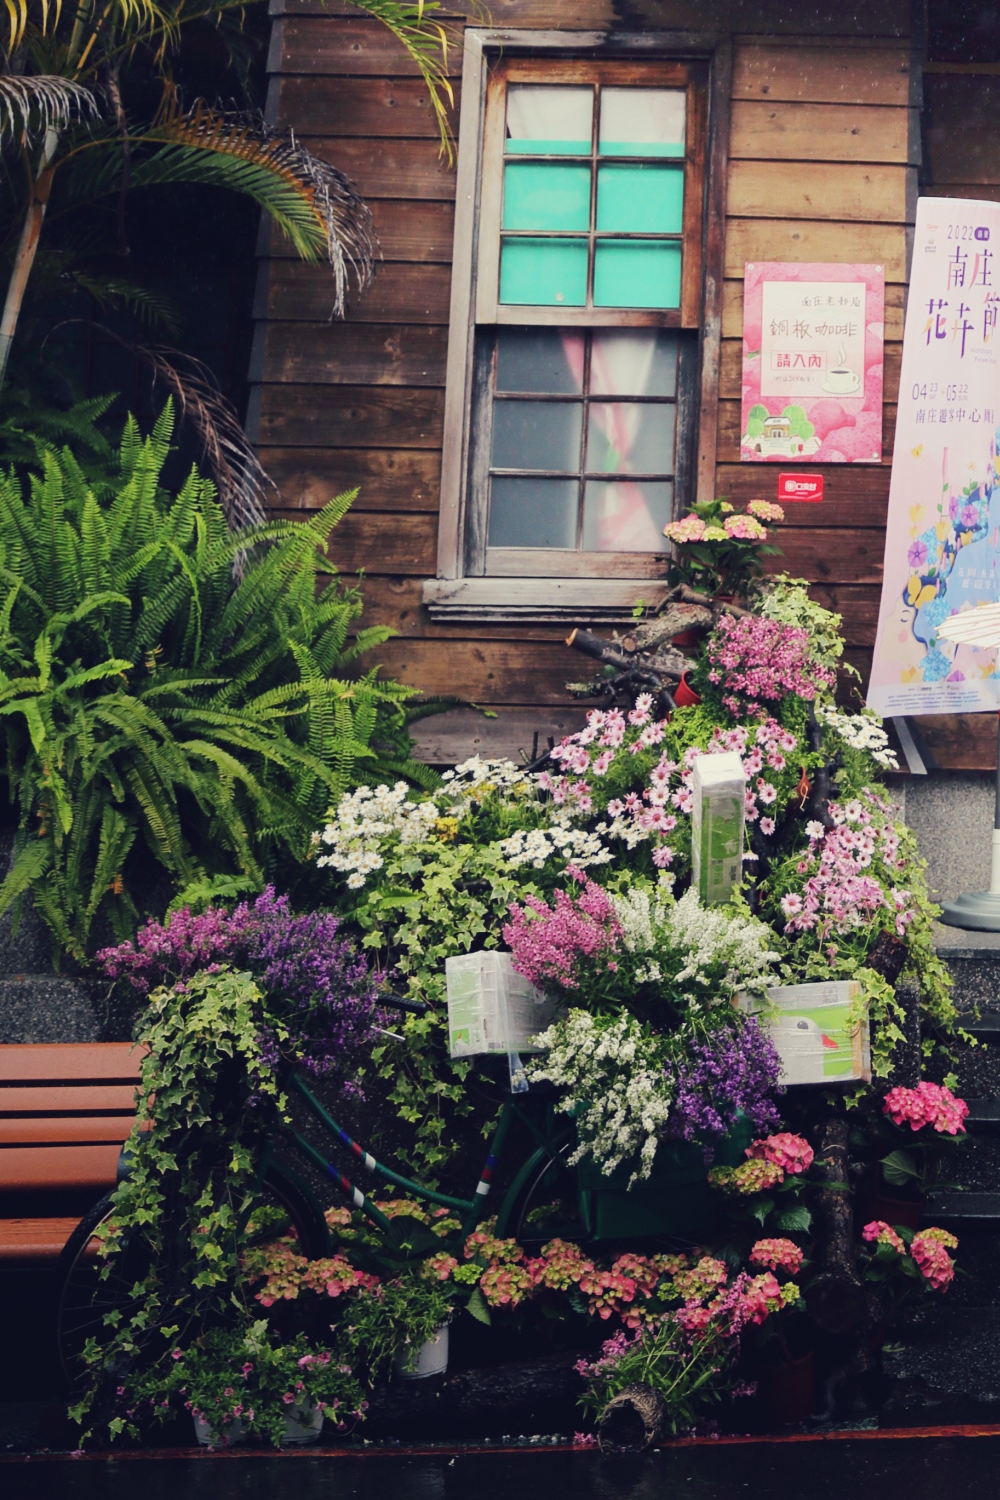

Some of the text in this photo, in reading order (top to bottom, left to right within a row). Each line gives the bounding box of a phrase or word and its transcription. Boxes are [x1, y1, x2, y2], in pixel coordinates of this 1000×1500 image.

[947, 224, 974, 241] 2022
[947, 245, 994, 291] 南庄
[769, 318, 858, 339] 銅板咖啡
[776, 353, 822, 368] 請入內
[912, 382, 969, 401] 04 23 05 22
